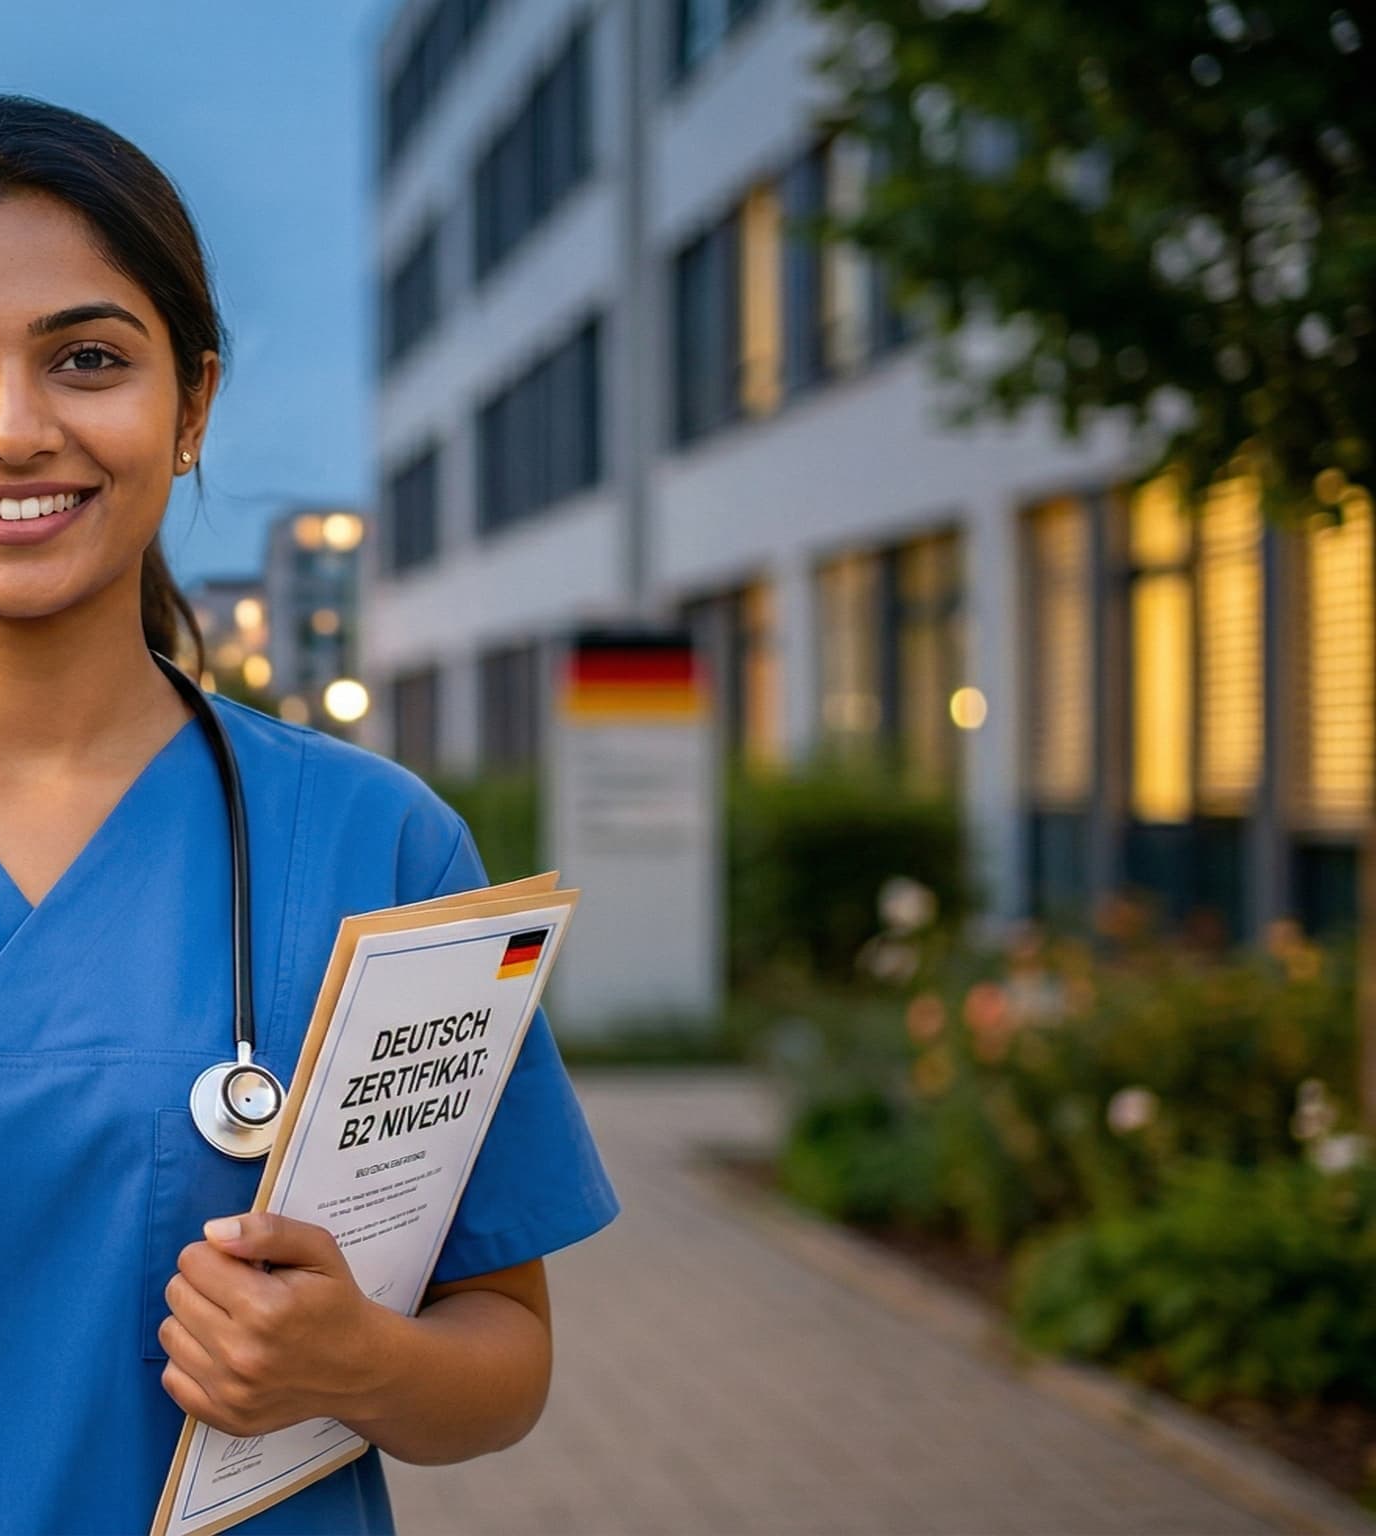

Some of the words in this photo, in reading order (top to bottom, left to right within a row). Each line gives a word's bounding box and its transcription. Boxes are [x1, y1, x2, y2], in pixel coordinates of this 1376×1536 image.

[371, 1008, 491, 1062] DEUTSCH
[340, 1048, 489, 1109] ZERTIFIKAT:
[338, 1115, 375, 1150] B2
[378, 1089, 471, 1141] NIVEAU
